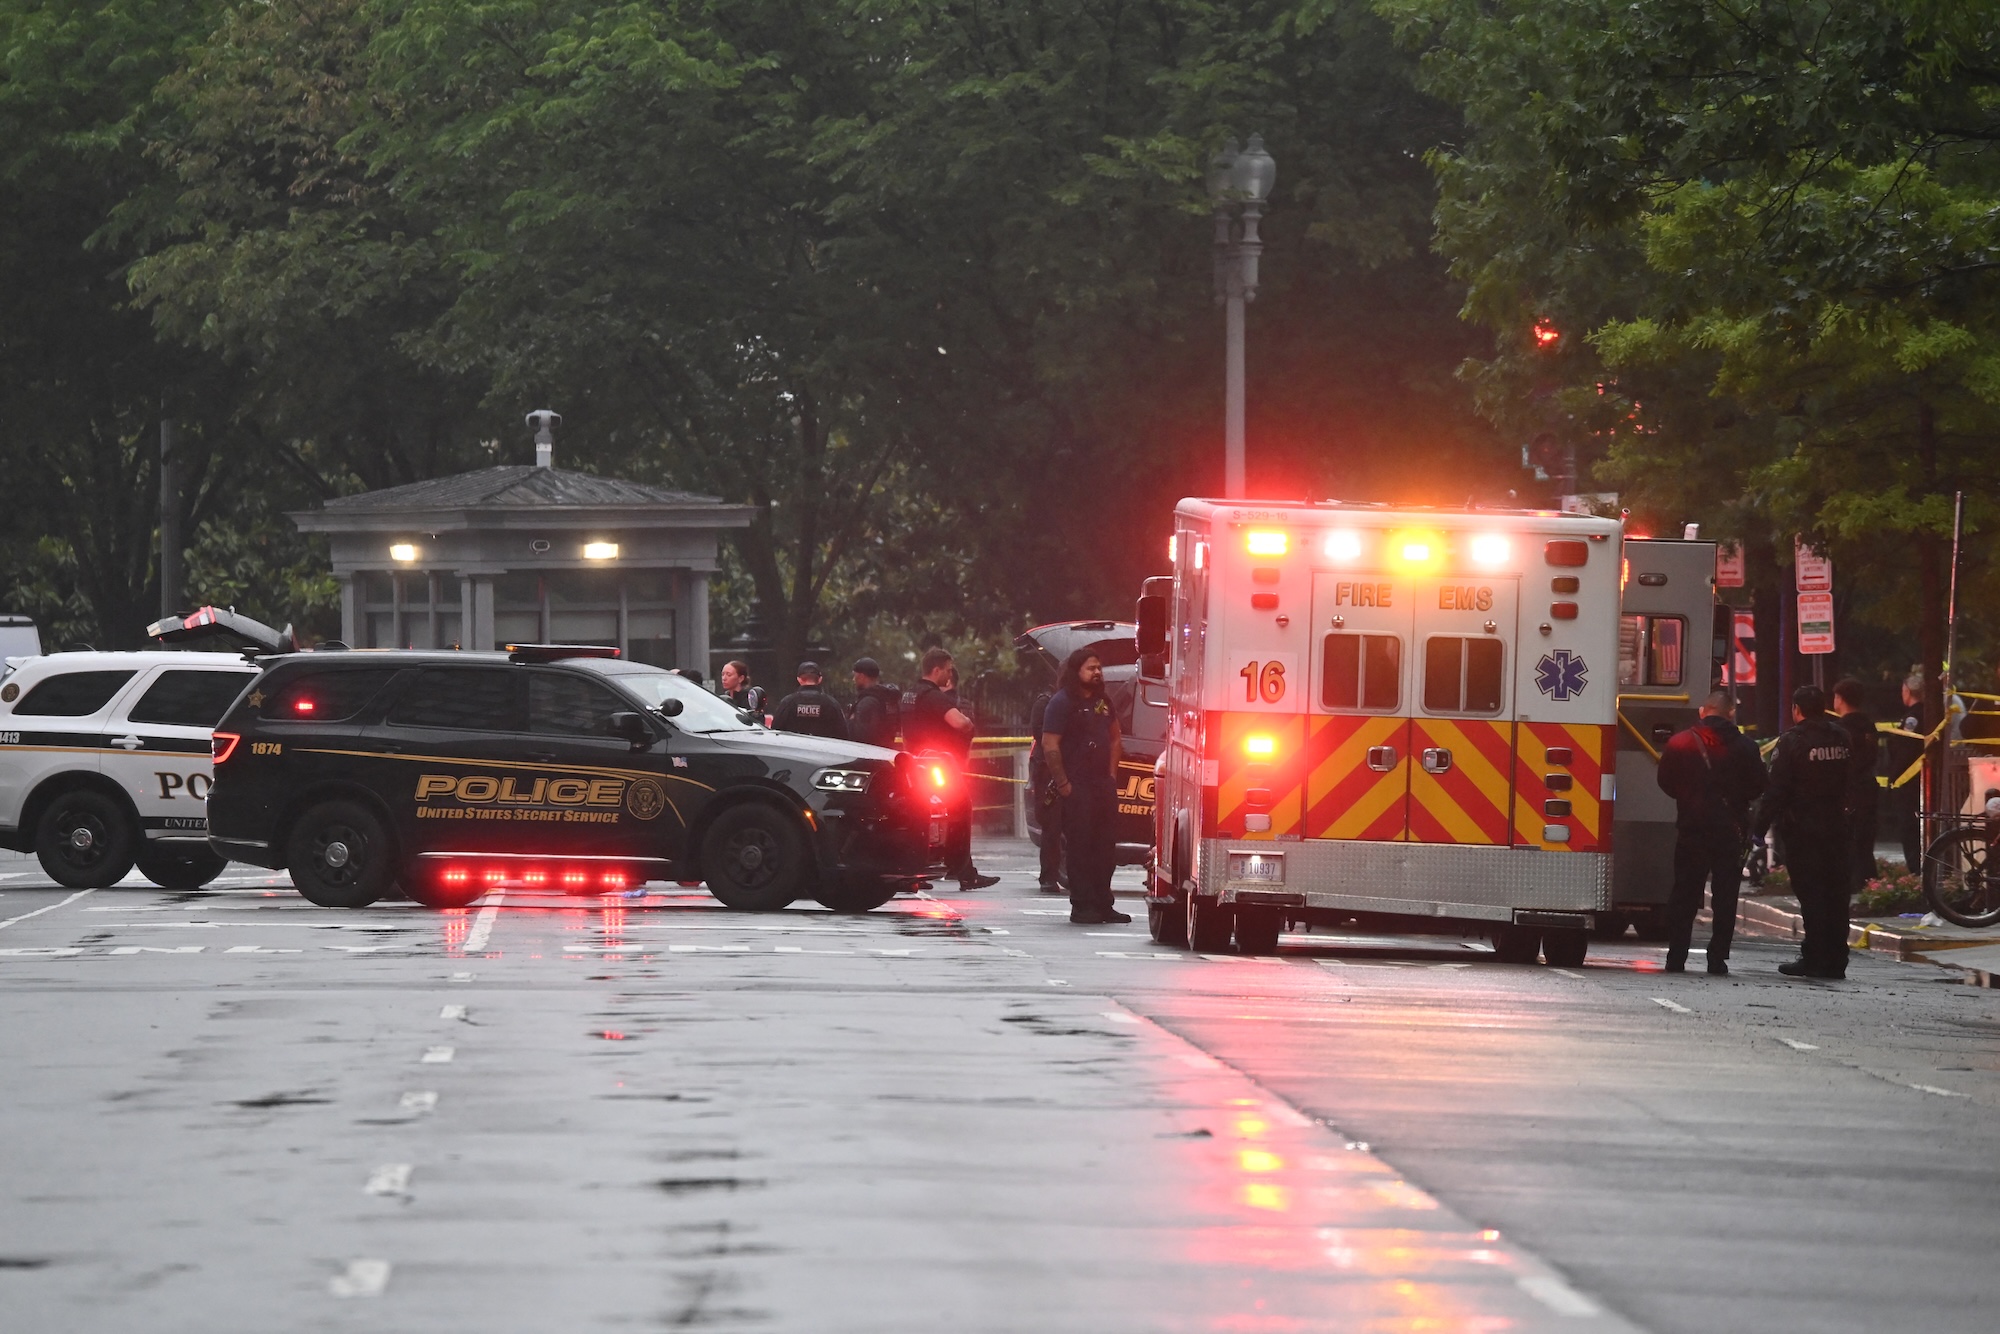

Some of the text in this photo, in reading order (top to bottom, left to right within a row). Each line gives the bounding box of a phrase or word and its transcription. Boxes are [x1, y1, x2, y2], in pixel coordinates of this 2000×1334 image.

[1233, 510, 1288, 521] S-529-16
[1335, 582, 1493, 612] FIRE EMS
[1240, 660, 1285, 704] 16
[797, 706, 820, 715] POLICE
[0, 731, 20, 744] 413
[251, 742, 282, 756] 1874
[414, 774, 626, 808] POLICE
[416, 806, 620, 824] UNITED STATES SECRET SERVICE
[164, 818, 207, 828] UNITE
[1249, 863, 1276, 875] 10937
